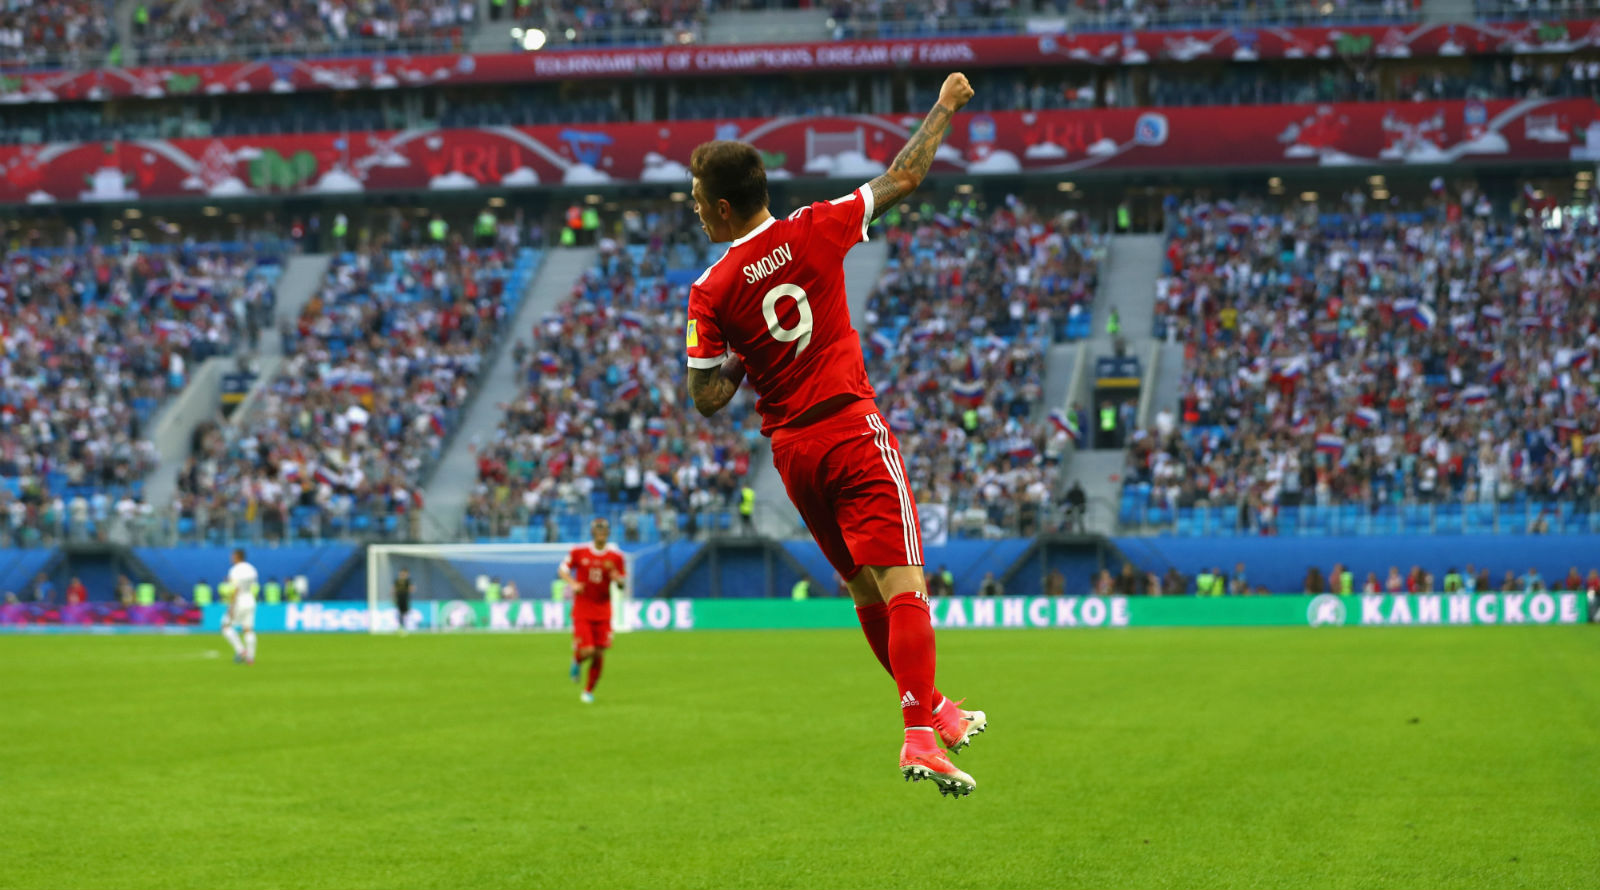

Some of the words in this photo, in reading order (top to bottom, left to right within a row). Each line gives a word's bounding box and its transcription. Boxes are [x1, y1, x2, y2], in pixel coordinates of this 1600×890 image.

[534, 52, 664, 75] TOURNAMENT
[666, 51, 690, 70] OF
[816, 46, 887, 65] DREAM
[890, 46, 914, 63] OF
[743, 243, 792, 284] SMOLOV
[762, 283, 814, 359] 9
[1362, 594, 1578, 624] КЛИНСКОЕ
